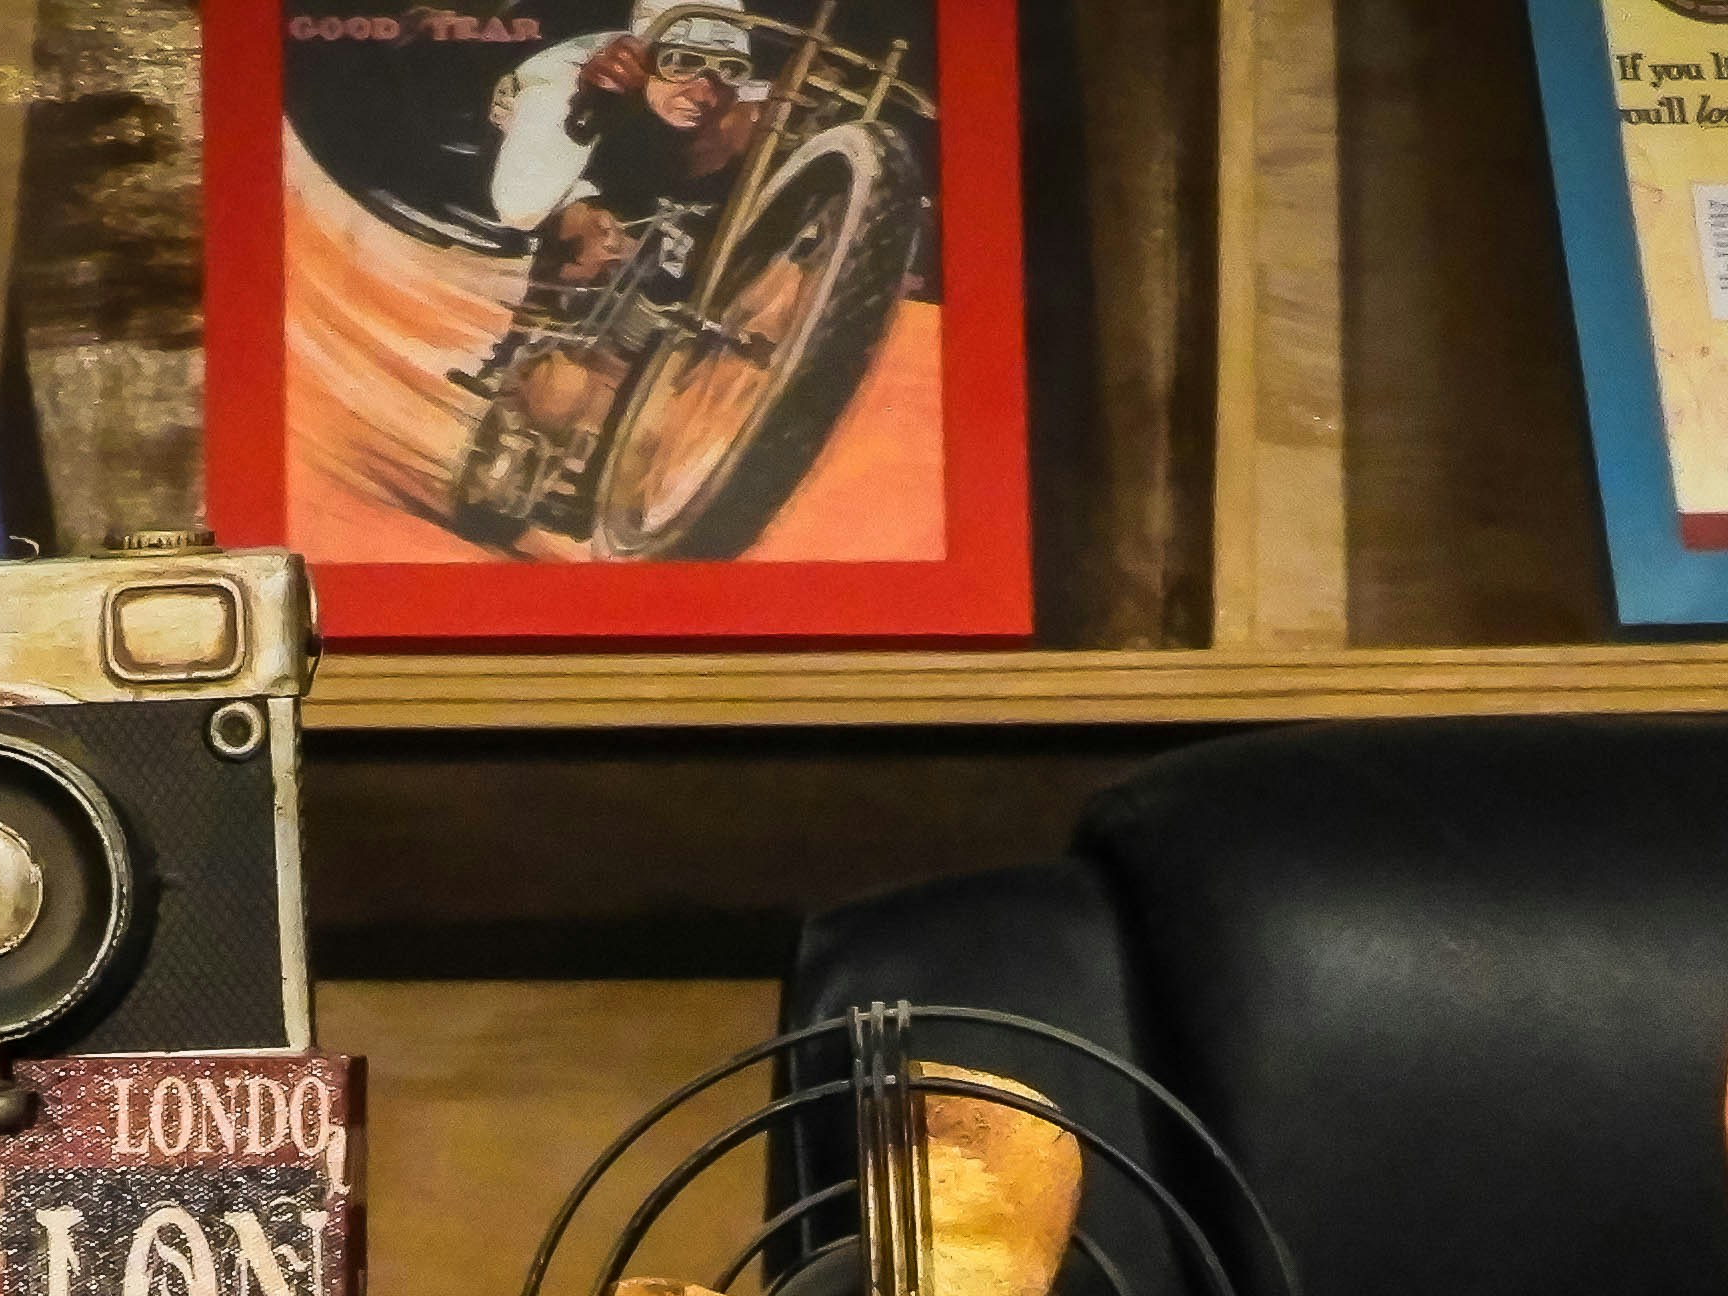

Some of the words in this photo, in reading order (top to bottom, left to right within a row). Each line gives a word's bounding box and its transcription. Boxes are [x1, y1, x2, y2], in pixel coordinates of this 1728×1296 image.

[289, 16, 401, 41] GOOD
[1616, 53, 1645, 81] If
[1648, 64, 1706, 88] you
